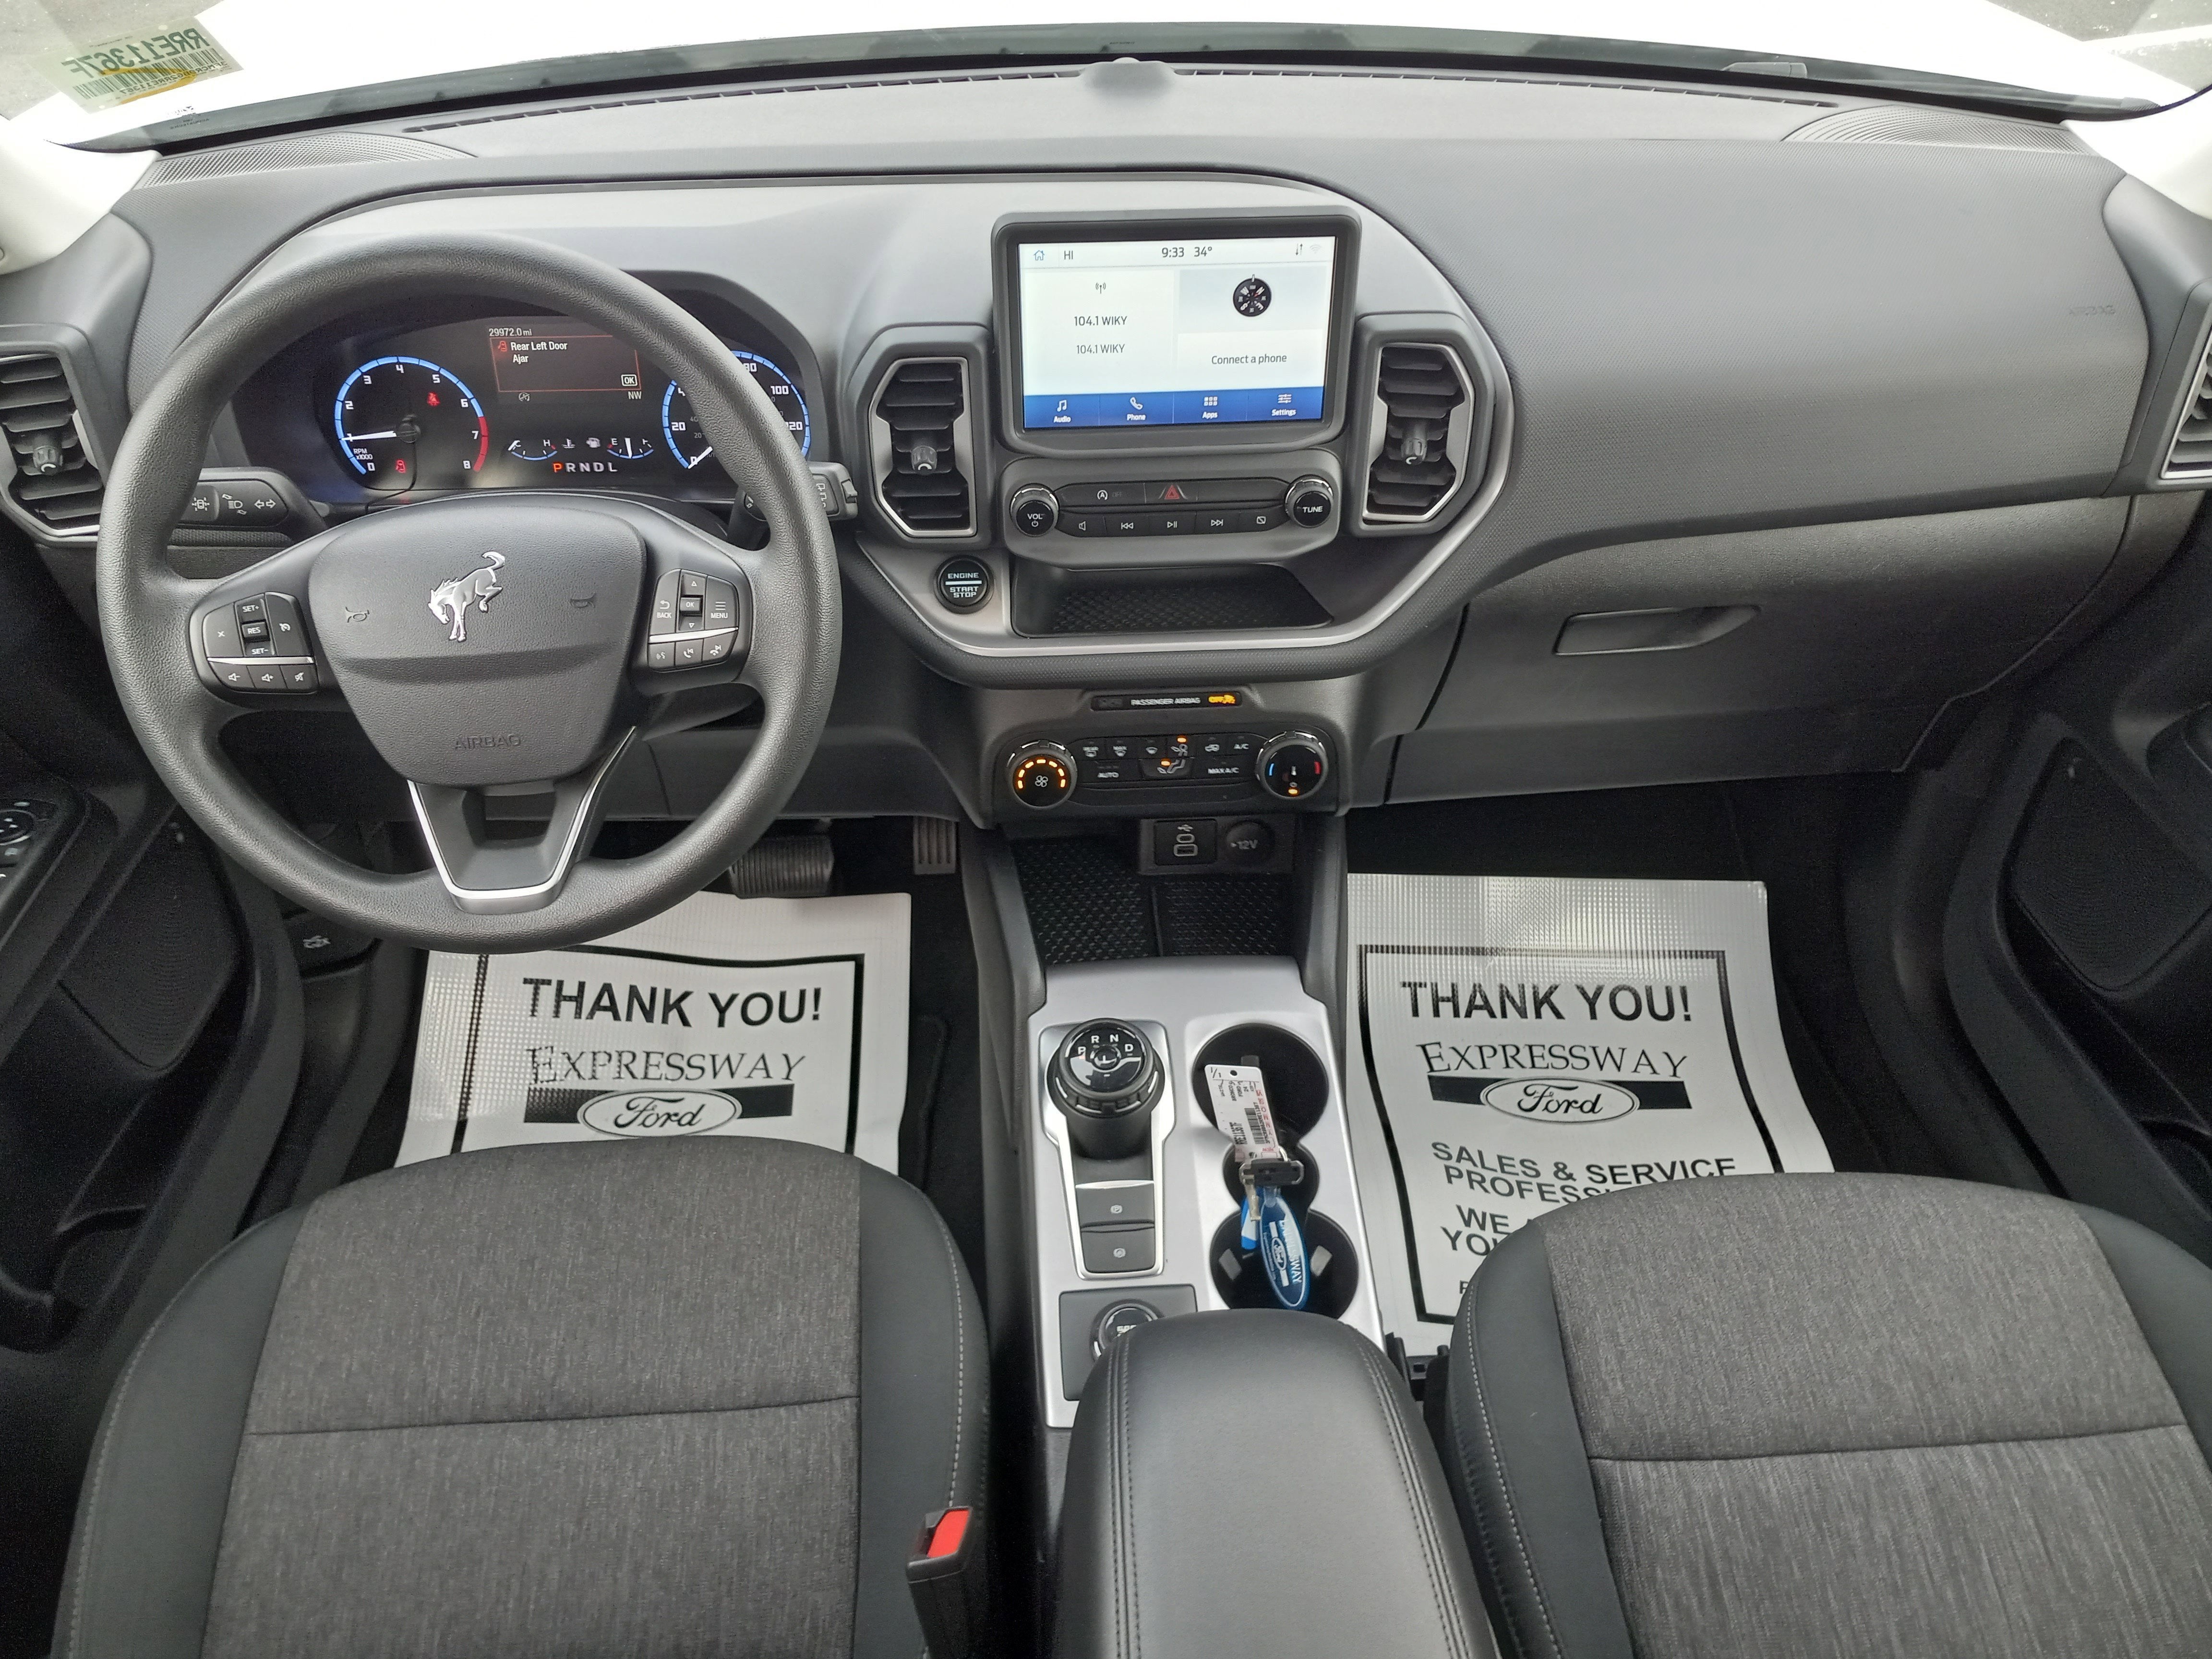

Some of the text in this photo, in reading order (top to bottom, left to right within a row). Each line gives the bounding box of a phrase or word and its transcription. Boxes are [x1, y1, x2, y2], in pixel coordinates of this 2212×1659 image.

[1064, 251, 1073, 260] HI
[1162, 246, 1213, 258] 9:33 34°
[1074, 315, 1127, 326] 104.1 WIKY
[489, 328, 522, 337] 29972.0
[510, 341, 567, 351] Rear Left Door
[1076, 344, 1125, 354] 104.1 WIKY
[513, 354, 529, 364] Ajar
[1211, 355, 1249, 365] Connect
[1258, 354, 1287, 365] phone
[395, 364, 404, 373] 4
[363, 375, 372, 385] 3
[432, 374, 440, 383] 5
[624, 376, 635, 385] OK
[628, 391, 642, 399] NW
[770, 386, 789, 395] 100
[345, 401, 354, 409] 2
[460, 398, 469, 408] 6
[1127, 413, 1146, 421] Phone
[1202, 411, 1218, 419] Apps
[671, 422, 686, 431] 20
[471, 431, 479, 440] 7
[367, 462, 375, 471] 0
[463, 460, 471, 469] 8
[553, 462, 618, 473] P R N D L
[453, 733, 522, 751] AIRBAG
[522, 977, 822, 1029] THANK YOU!
[1401, 981, 1693, 1022] THANK YOU!
[1091, 1034, 1119, 1043] R N
[1125, 1044, 1134, 1052] D
[1416, 1041, 1687, 1079] EXPRESSWAY
[526, 1046, 805, 1086] EXPRESSWAY
[1517, 1082, 1605, 1115] Ford
[614, 1096, 704, 1129] Ford
[1431, 1141, 1736, 1185] SALES & SERVICE
[1455, 1204, 1511, 1236] WE
[1440, 1226, 1499, 1256] YO
